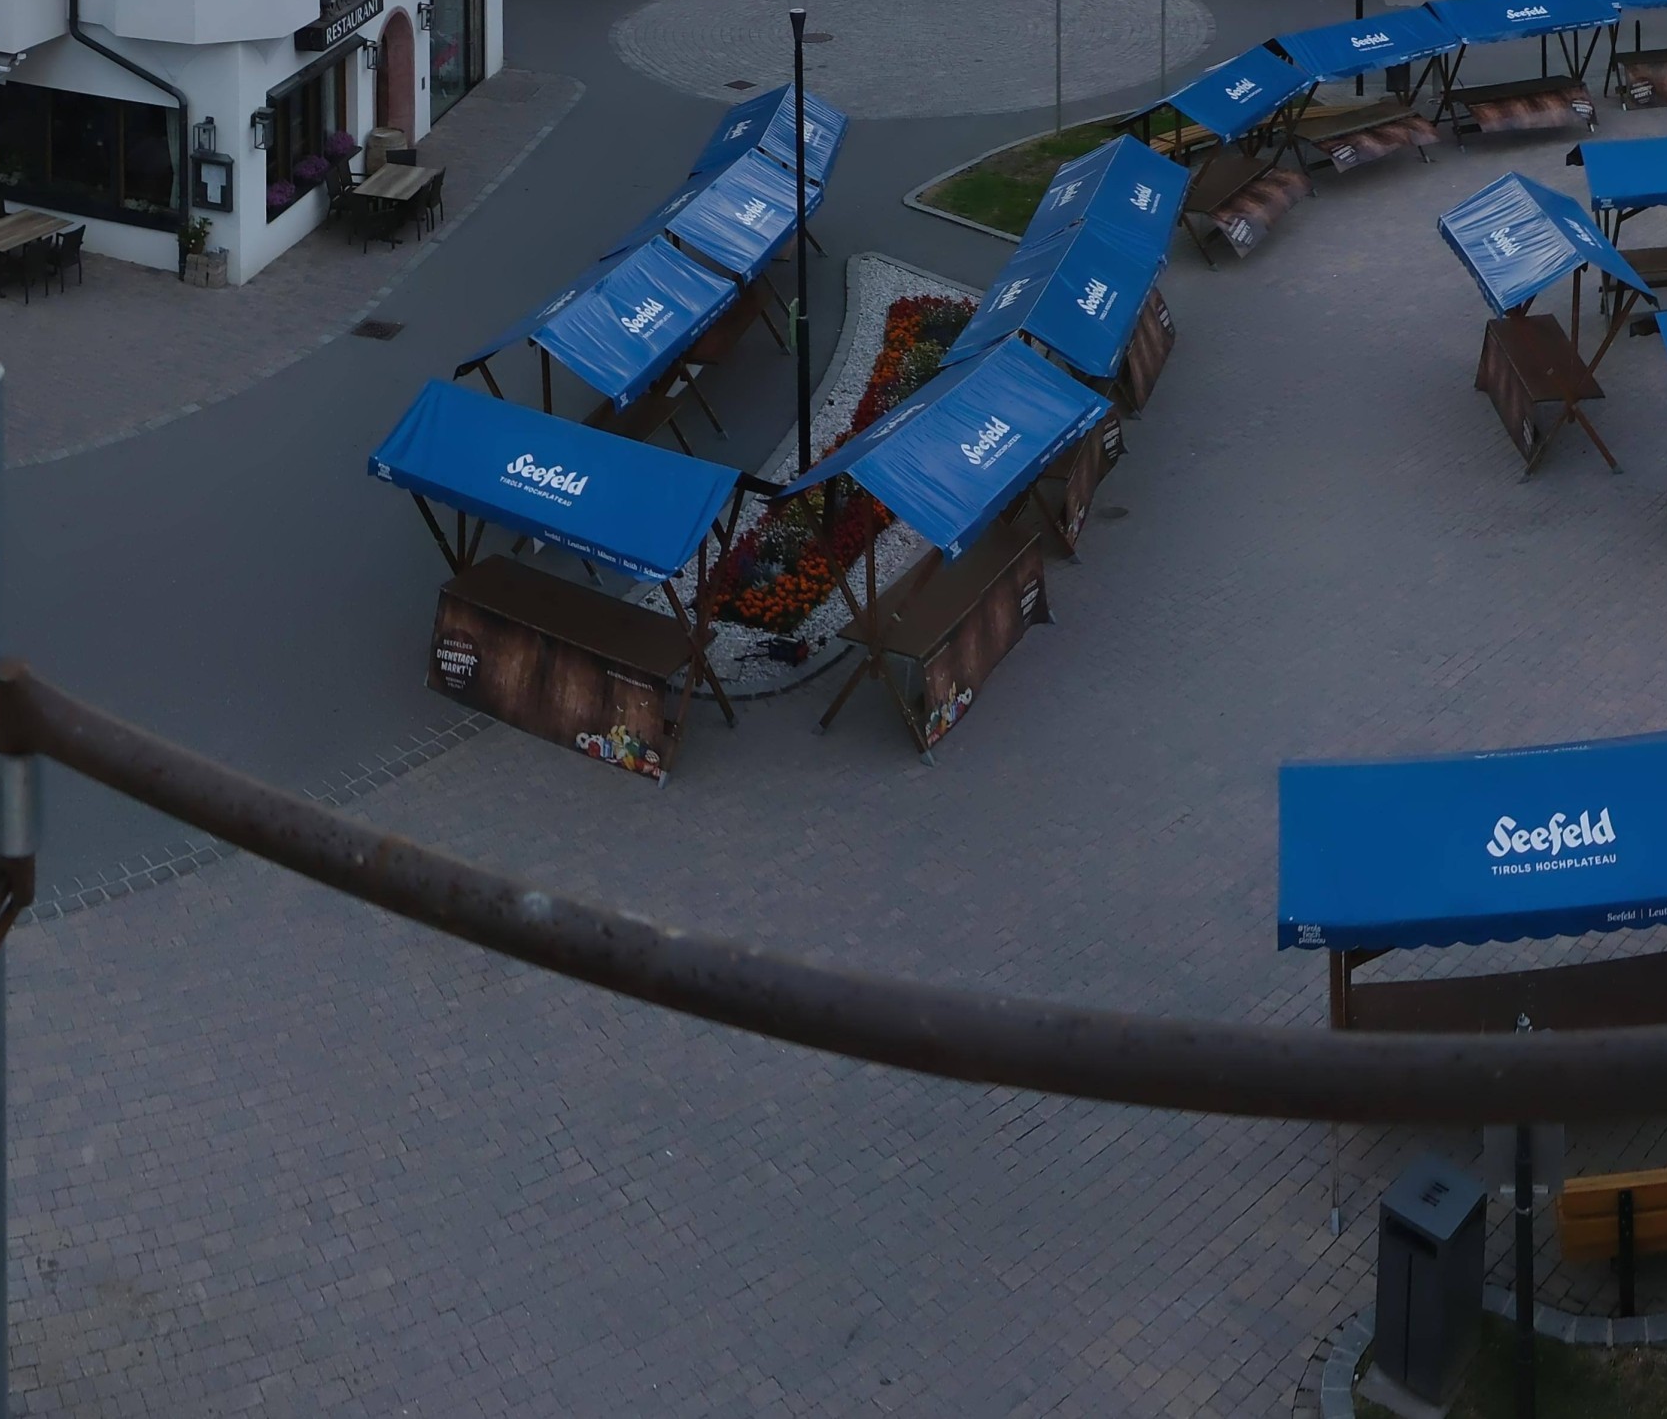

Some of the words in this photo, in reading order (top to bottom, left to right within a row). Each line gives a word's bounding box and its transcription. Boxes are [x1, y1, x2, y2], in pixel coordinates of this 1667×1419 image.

[1506, 5, 1548, 19] Seefeld
[1351, 32, 1390, 48] Seefeld
[620, 296, 665, 334] Seefeld
[960, 415, 1011, 465] Seefeld
[506, 453, 590, 497] Seefeld
[1486, 807, 1618, 858] Seefeld
[1491, 863, 1532, 876] TIROLS
[1535, 854, 1617, 872] HOCHPLATEAU
[1607, 910, 1636, 923] Seefeld
